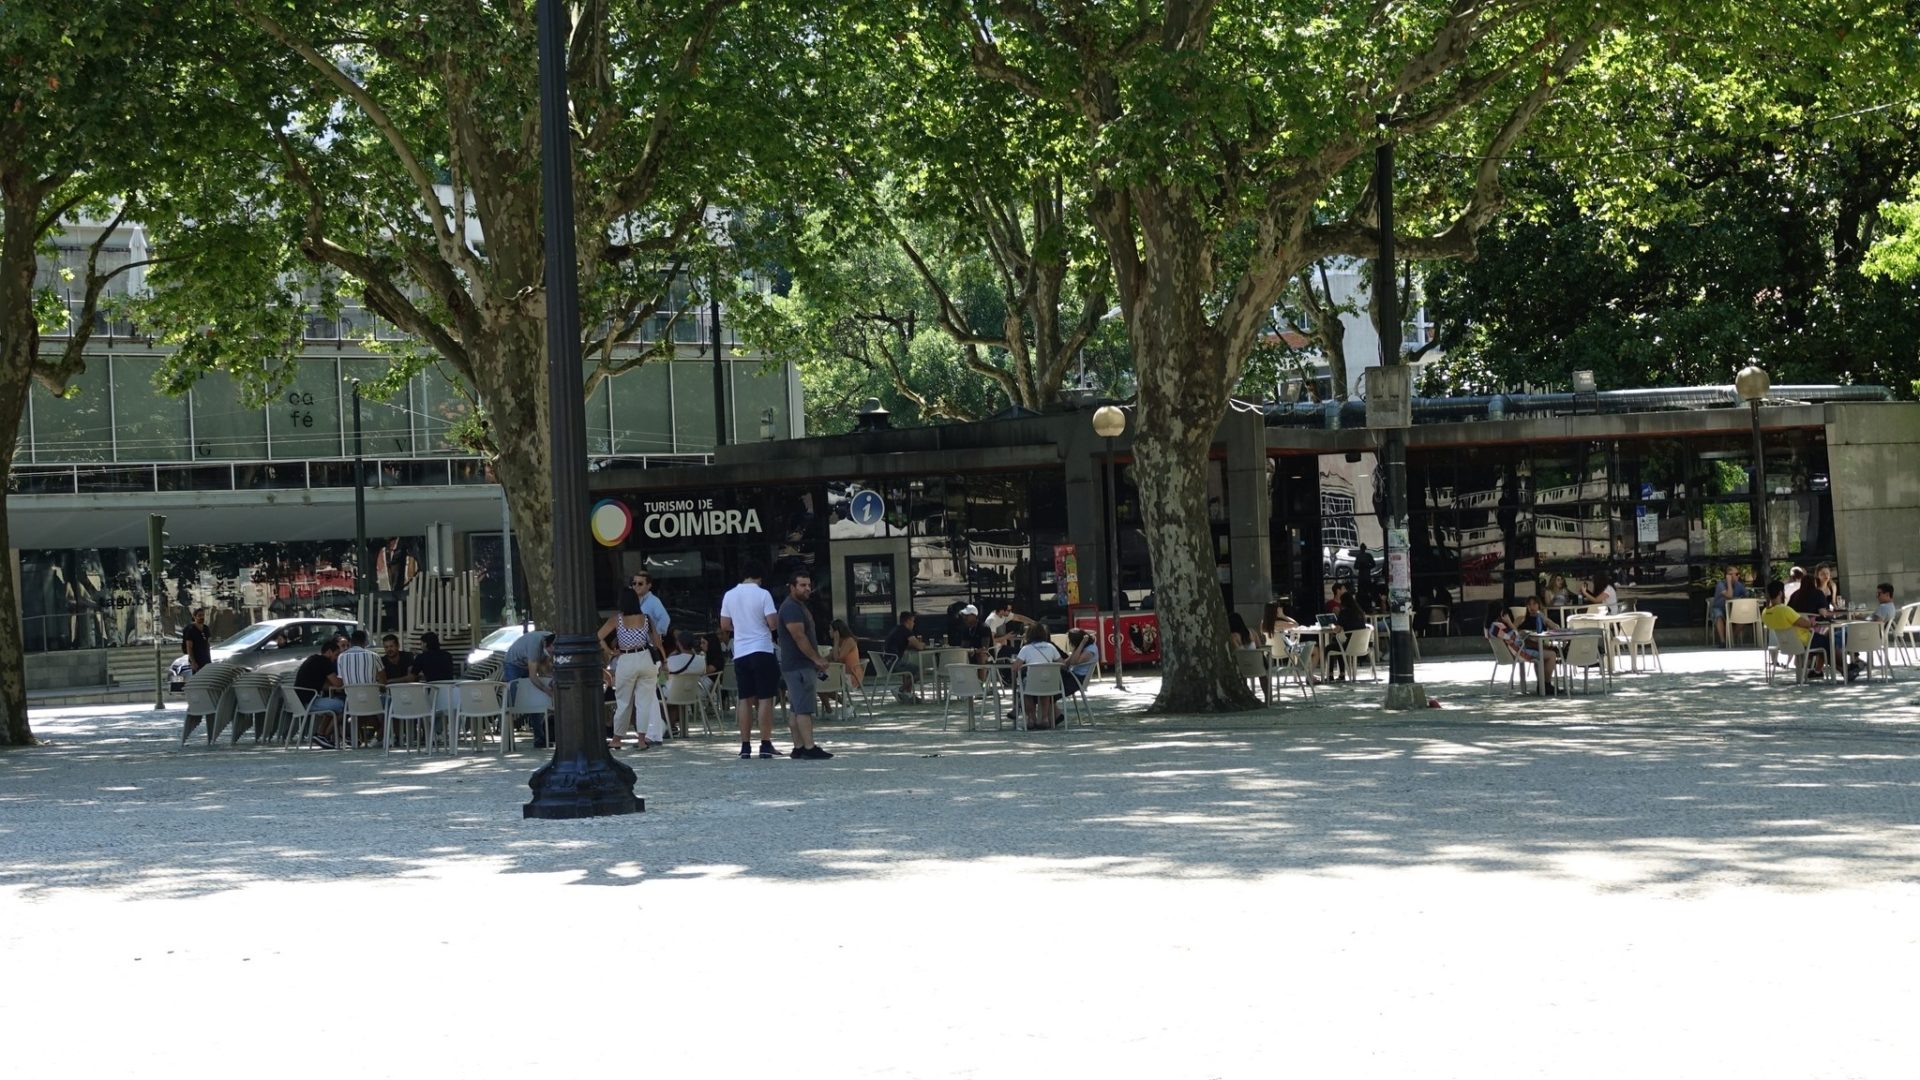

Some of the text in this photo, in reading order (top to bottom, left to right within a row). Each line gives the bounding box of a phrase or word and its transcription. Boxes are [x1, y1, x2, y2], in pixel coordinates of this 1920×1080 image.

[289, 391, 314, 405] ca
[290, 411, 313, 428] fé
[644, 499, 713, 513] TURISMO DE
[643, 508, 763, 539] COIMBRA
